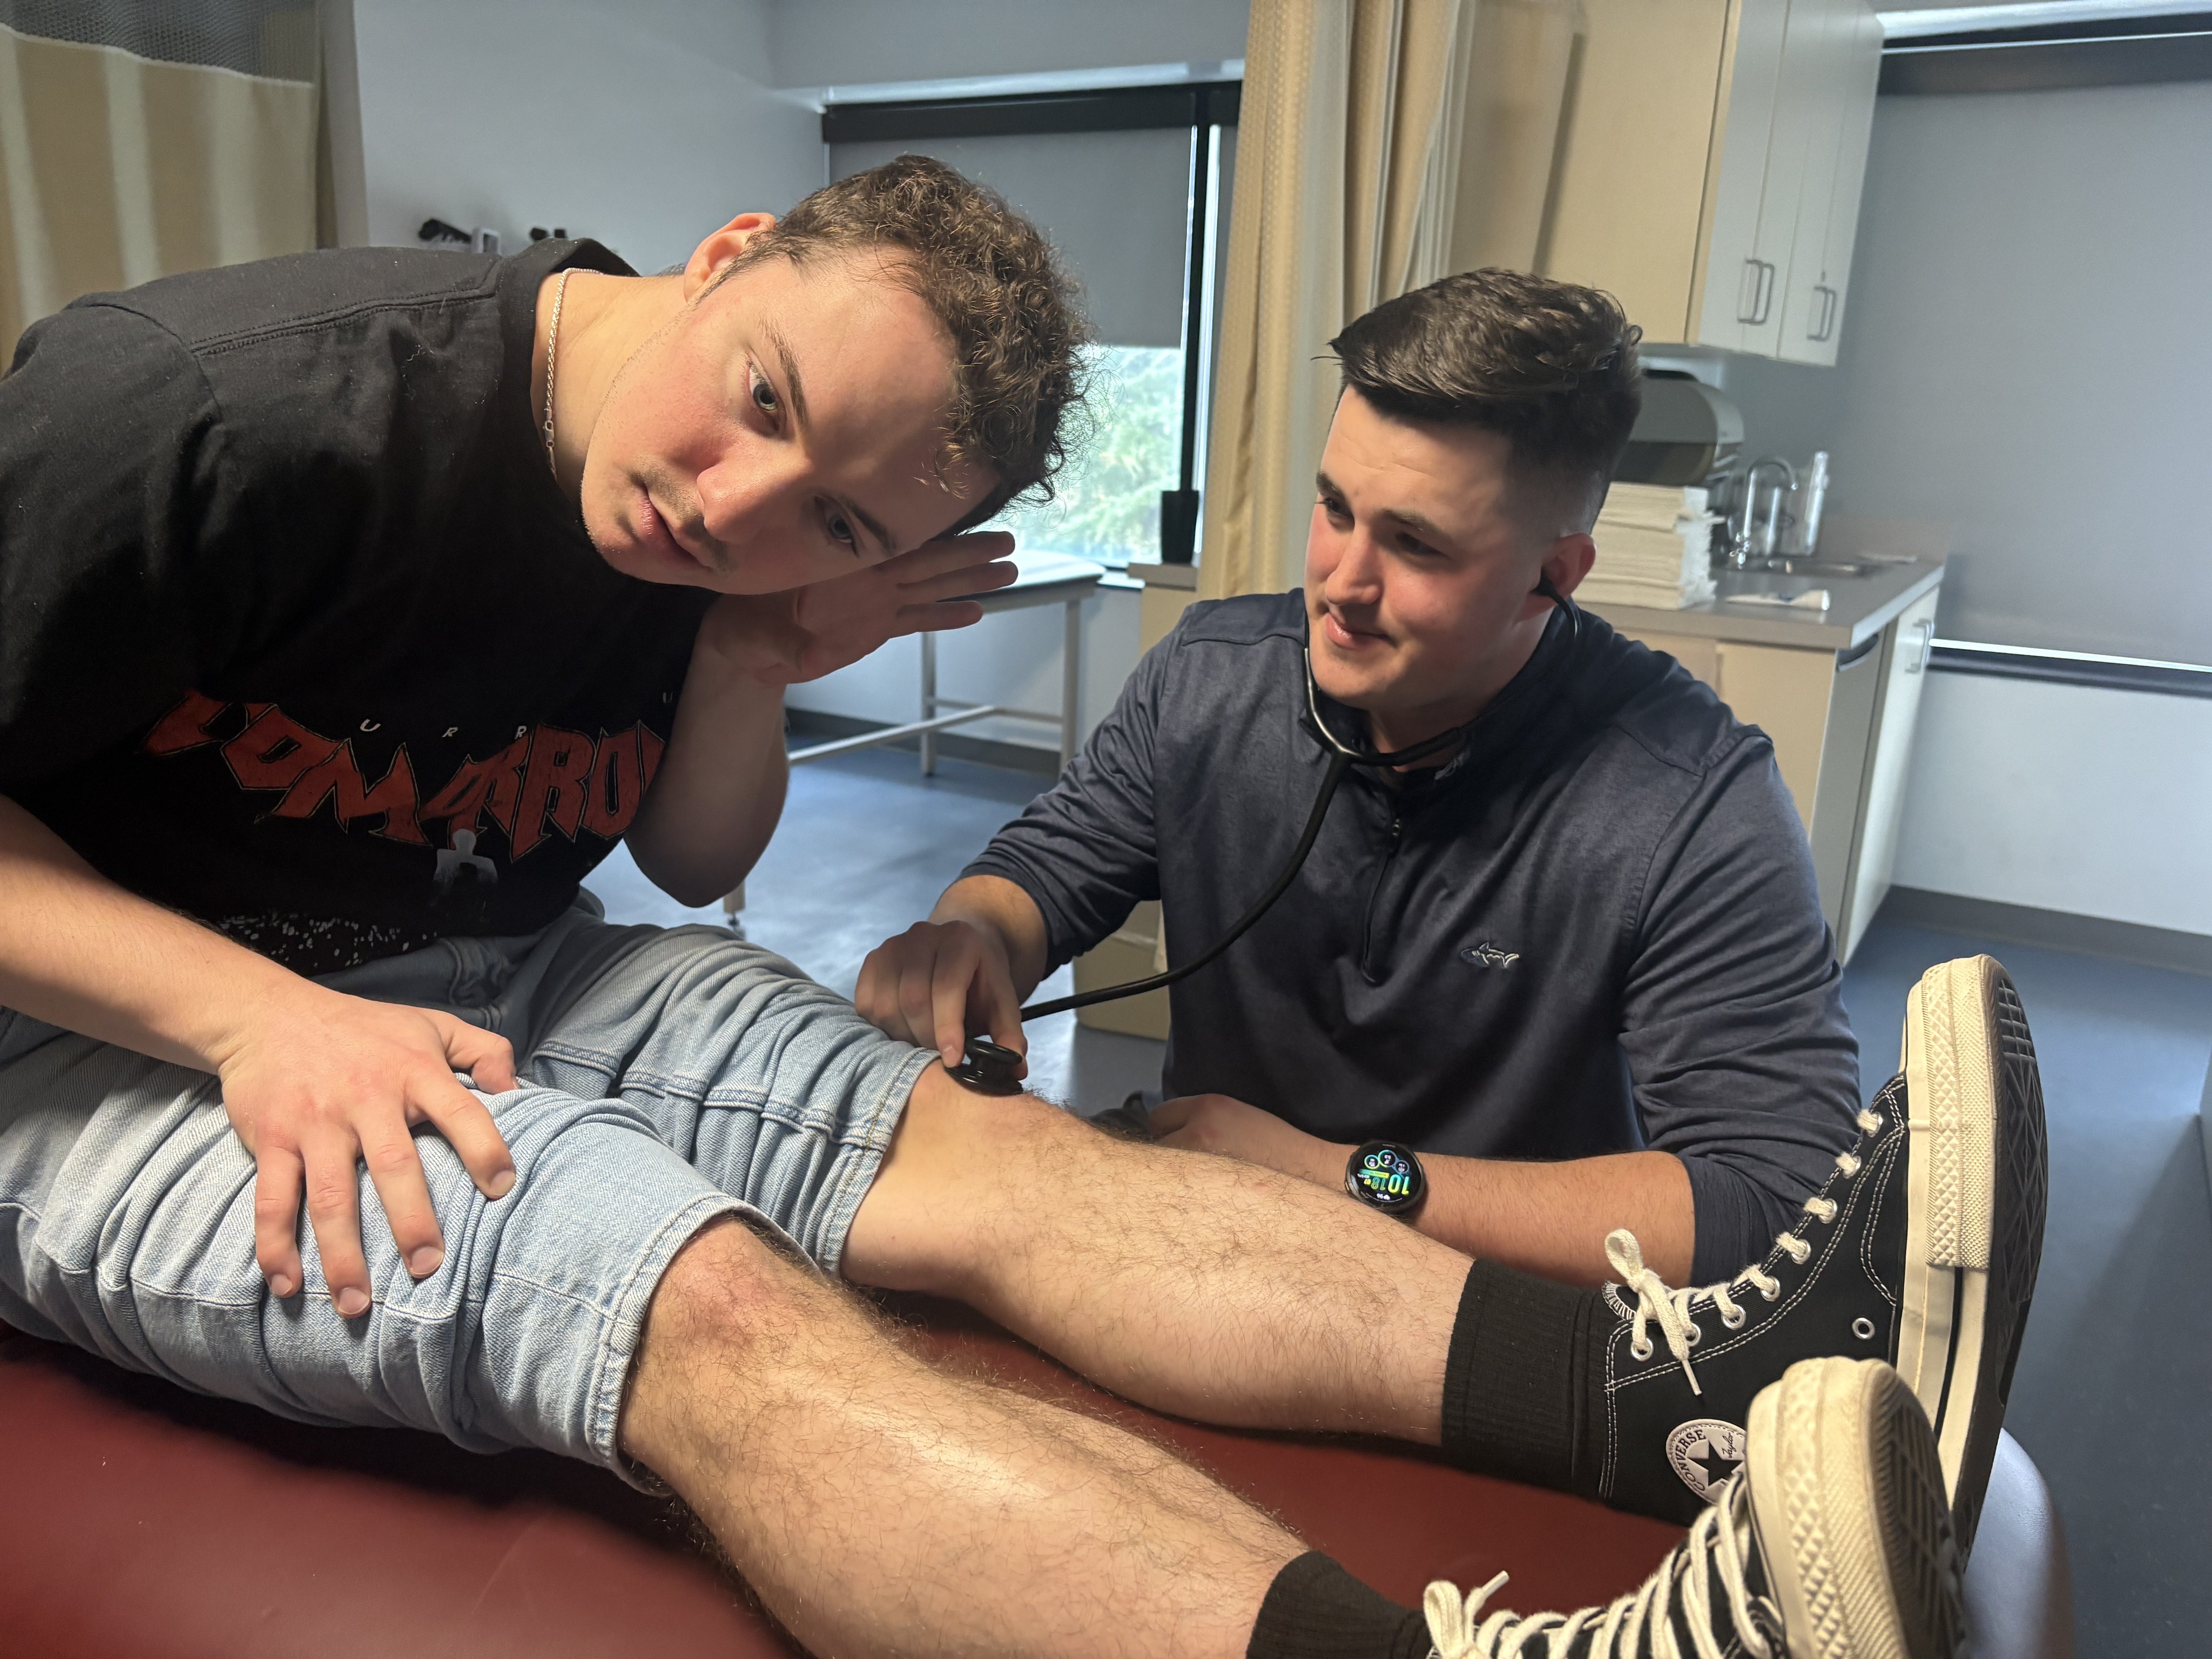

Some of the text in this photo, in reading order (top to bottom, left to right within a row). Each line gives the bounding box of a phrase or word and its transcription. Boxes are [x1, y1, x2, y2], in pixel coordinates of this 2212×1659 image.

[140, 688, 665, 863] OMORRO
[1371, 1177, 1386, 1191] 18
[1387, 1174, 1410, 1195] 10
[1722, 1433, 1737, 1459] Taylor
[1675, 1429, 1707, 1492] CONVERSE
